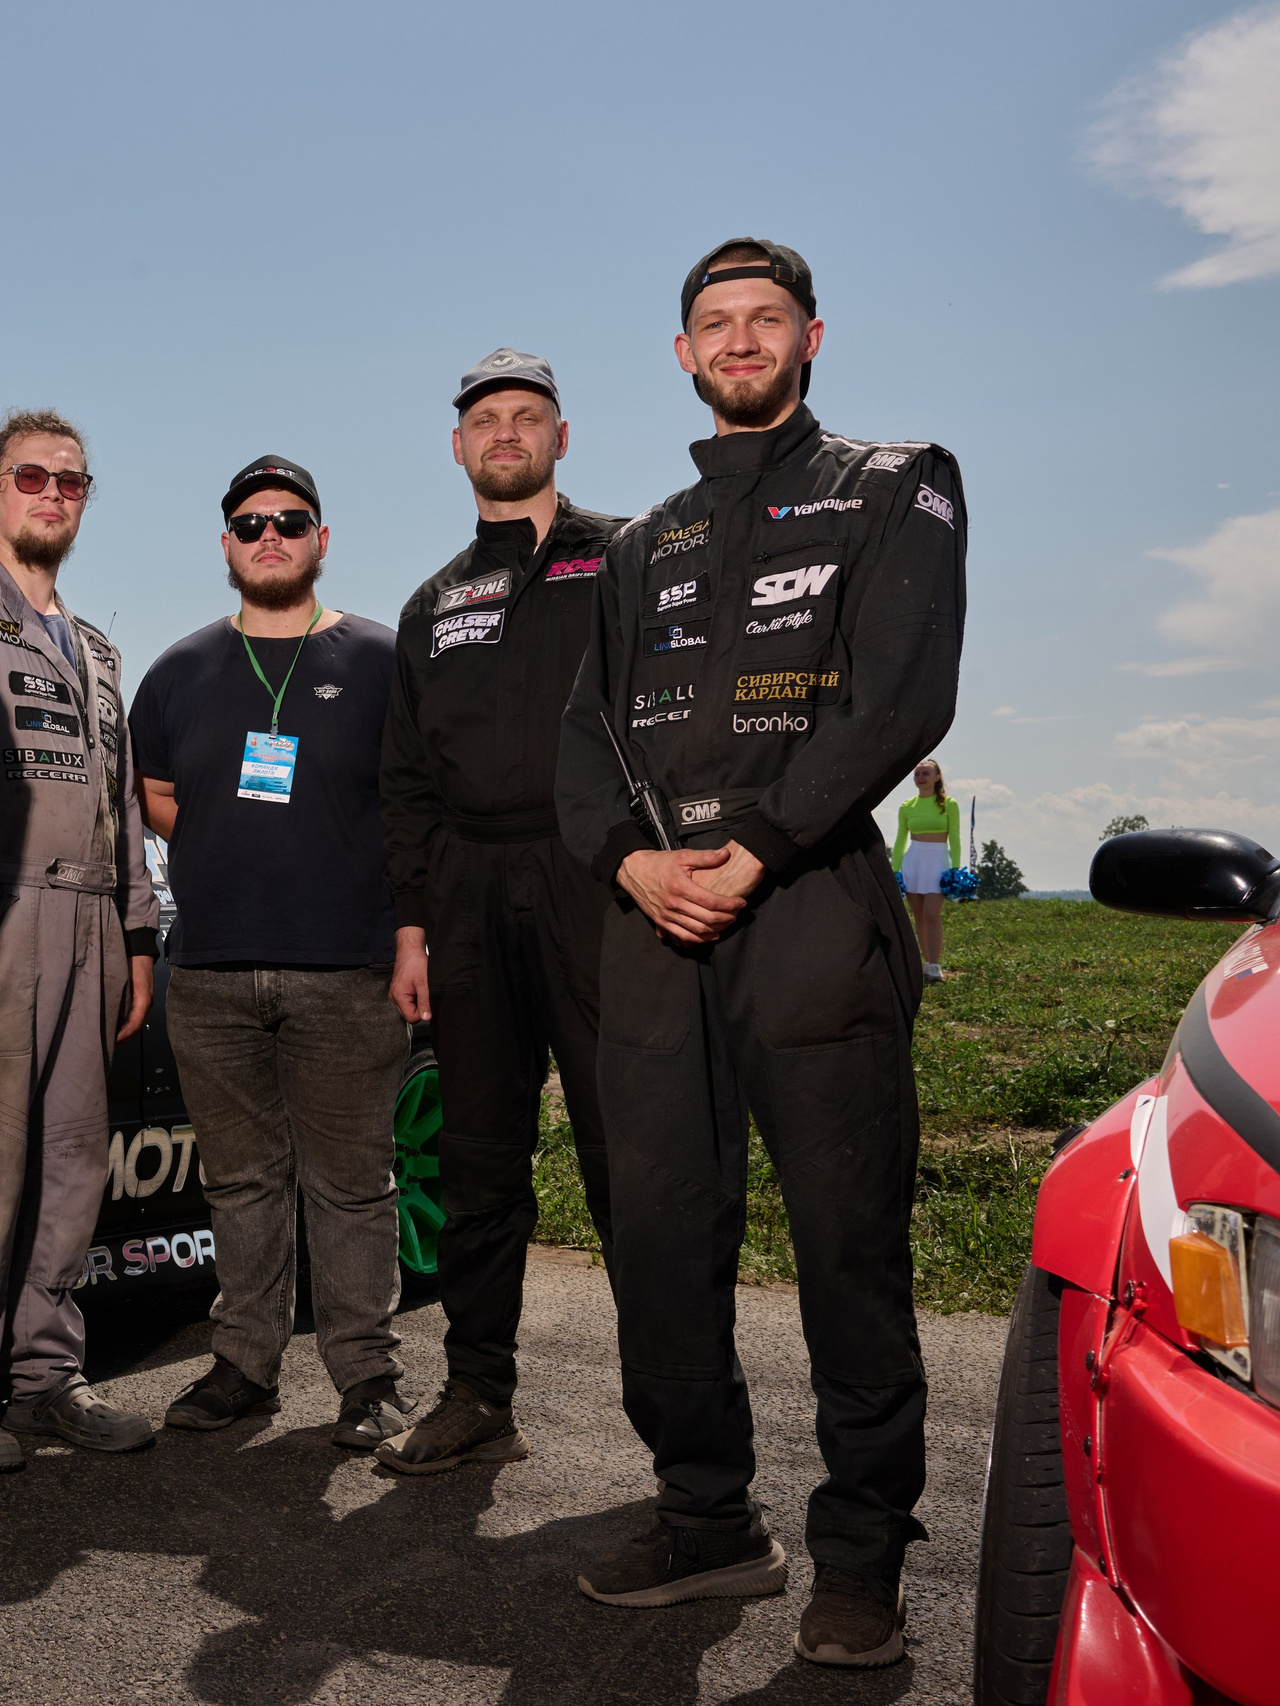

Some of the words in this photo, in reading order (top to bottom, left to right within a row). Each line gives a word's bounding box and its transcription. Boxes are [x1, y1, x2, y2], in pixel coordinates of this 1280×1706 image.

[868, 453, 906, 468] OMP
[793, 497, 863, 517] Valvoline
[917, 489, 955, 522] OMP
[658, 580, 697, 606] SSP
[751, 564, 839, 606] SCW
[435, 614, 501, 638] CHASER
[438, 628, 491, 649] CREW
[23, 675, 56, 693] SSP
[737, 671, 840, 688] СИБИРСКИЙ
[734, 685, 808, 701] КАРДАН
[26, 720, 70, 733] LINKGLOBAL
[733, 711, 809, 733] bronko
[5, 749, 83, 767] SIBALUX
[7, 769, 87, 783] RECERA
[681, 802, 721, 822] OMP
[122, 1229, 216, 1277] SPOR
